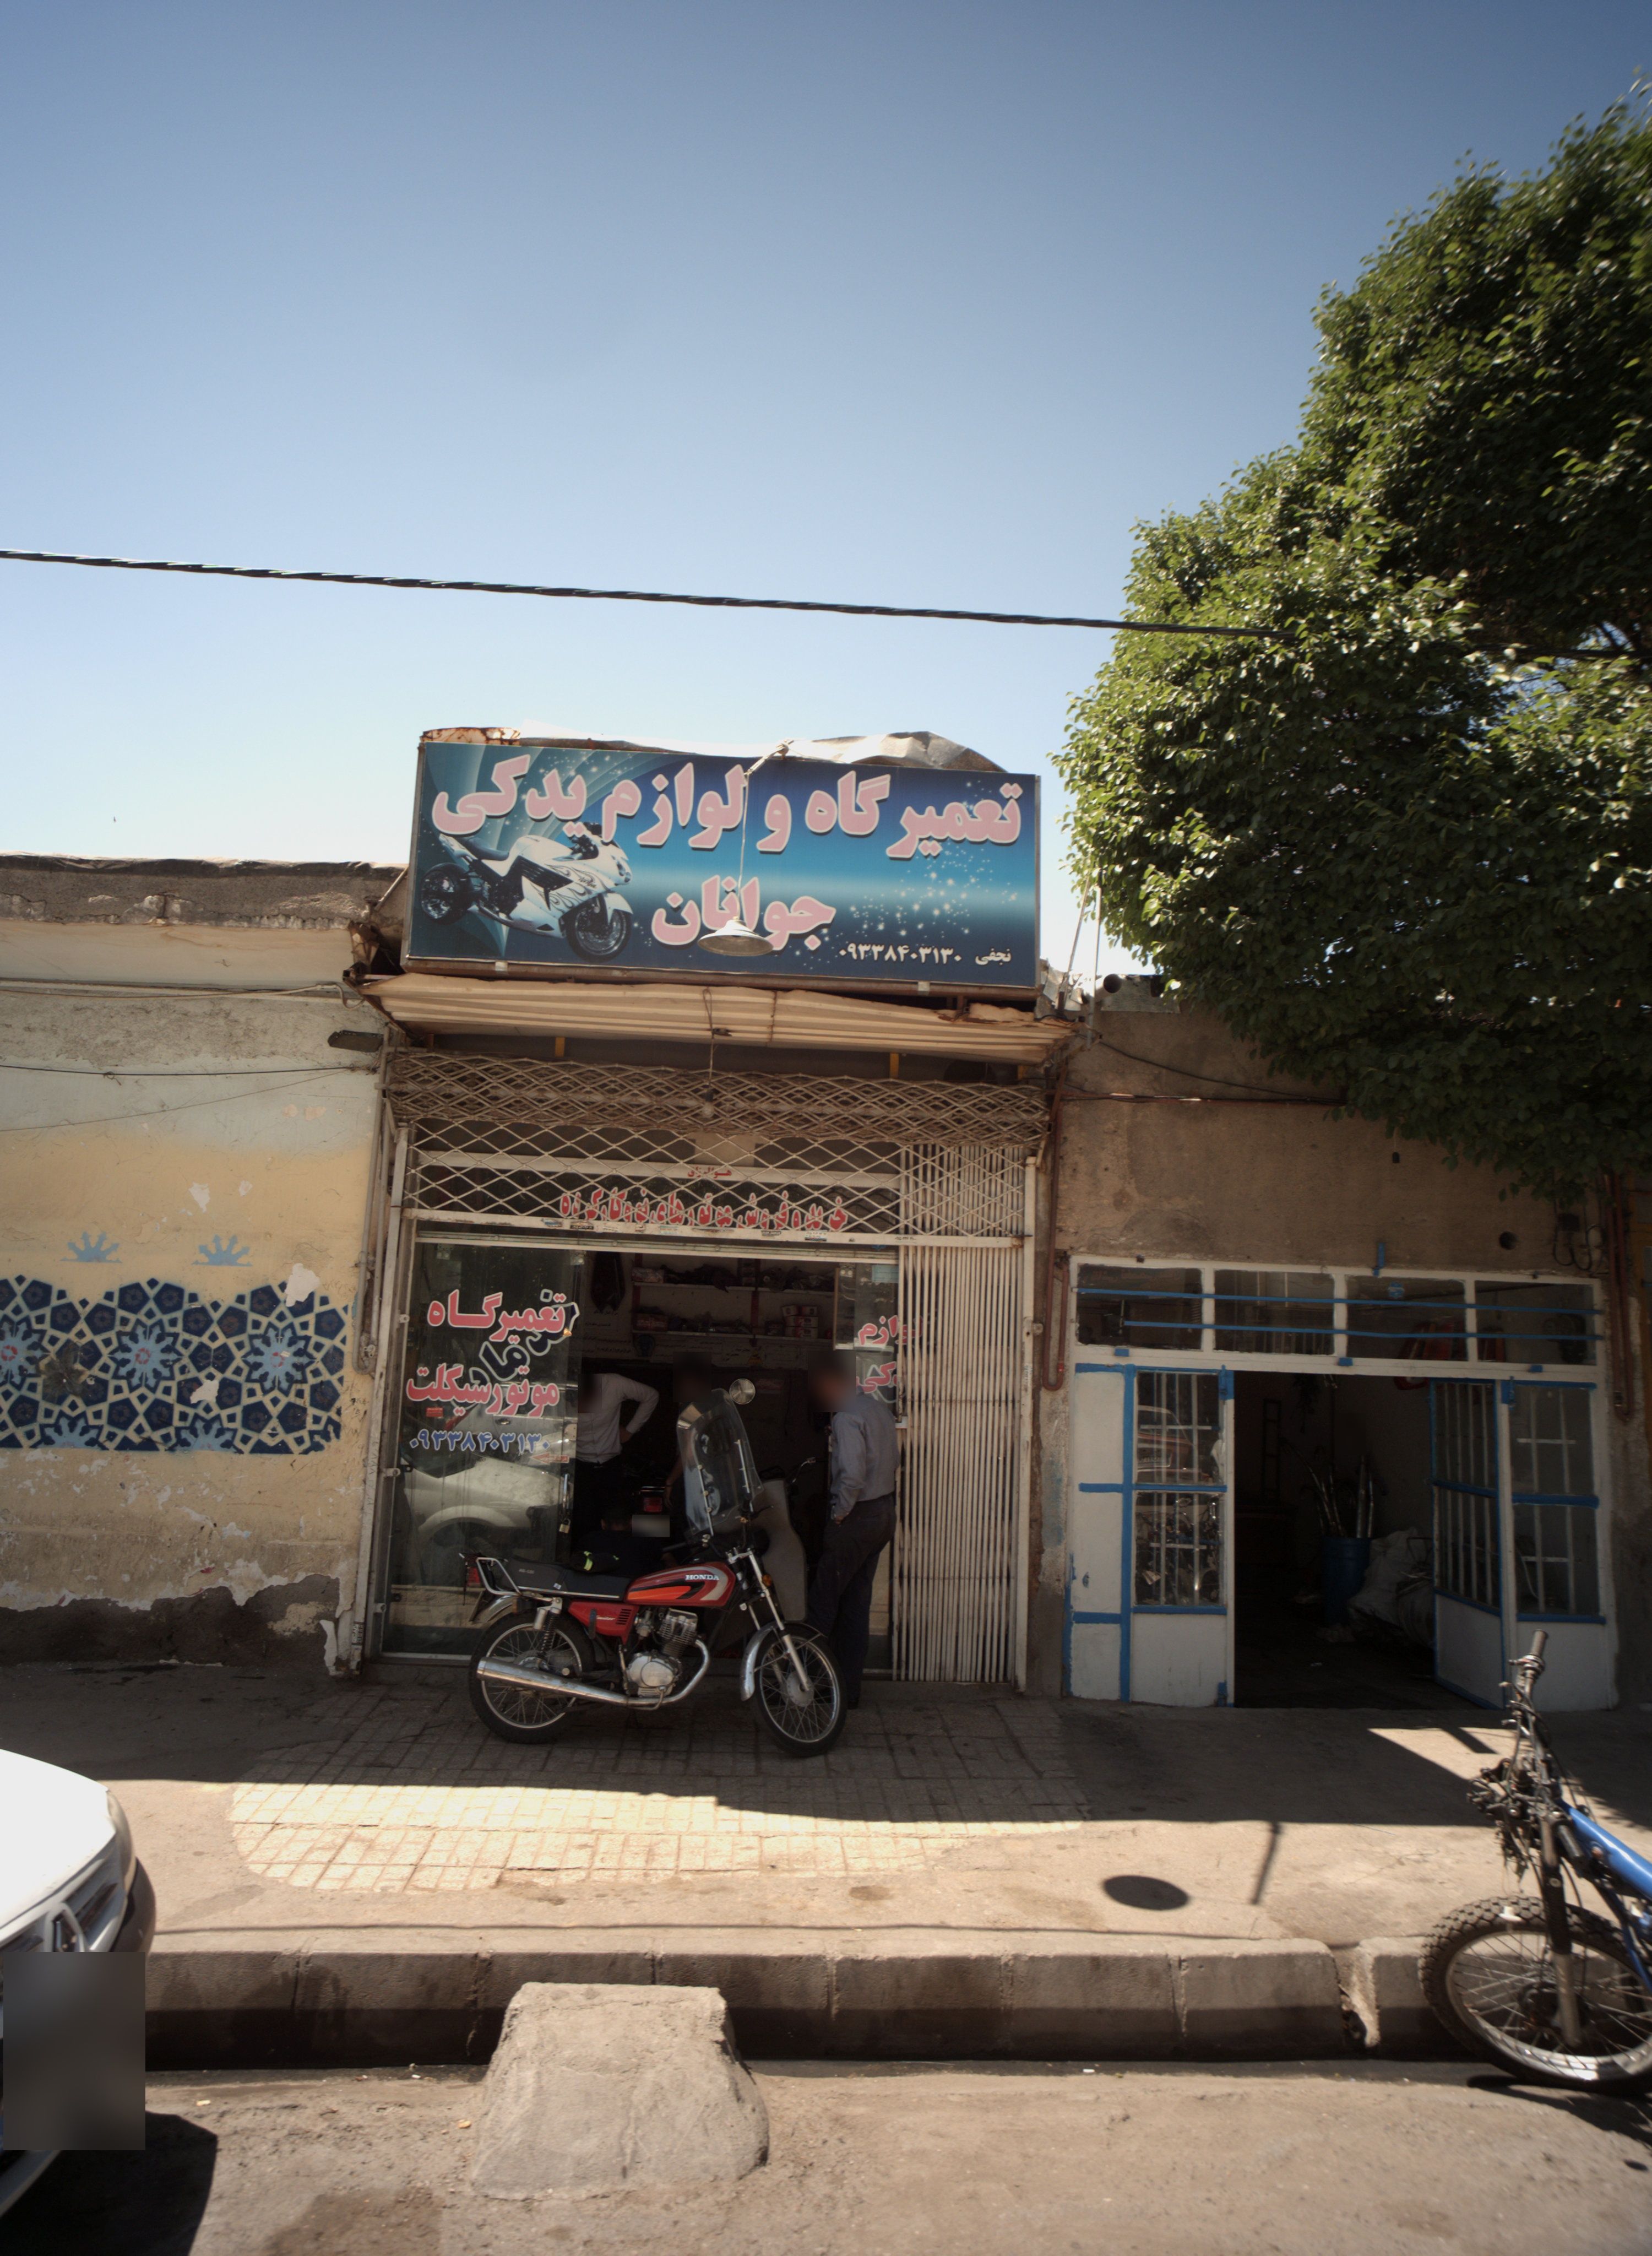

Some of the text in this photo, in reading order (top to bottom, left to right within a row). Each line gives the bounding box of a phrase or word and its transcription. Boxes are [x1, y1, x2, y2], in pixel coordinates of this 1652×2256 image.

[432, 753, 587, 839] یدکی
[601, 762, 747, 849] لوازم
[757, 793, 792, 853] و
[651, 875, 836, 951] جوانان
[839, 942, 1012, 966] ۰۹۳۳۸۴۰۳۱۳۰ نجفی
[427, 1289, 567, 1343] تعمیرگاه
[410, 1429, 550, 1453] ۰۹۳۳۸۴۰۳۱۳۰
